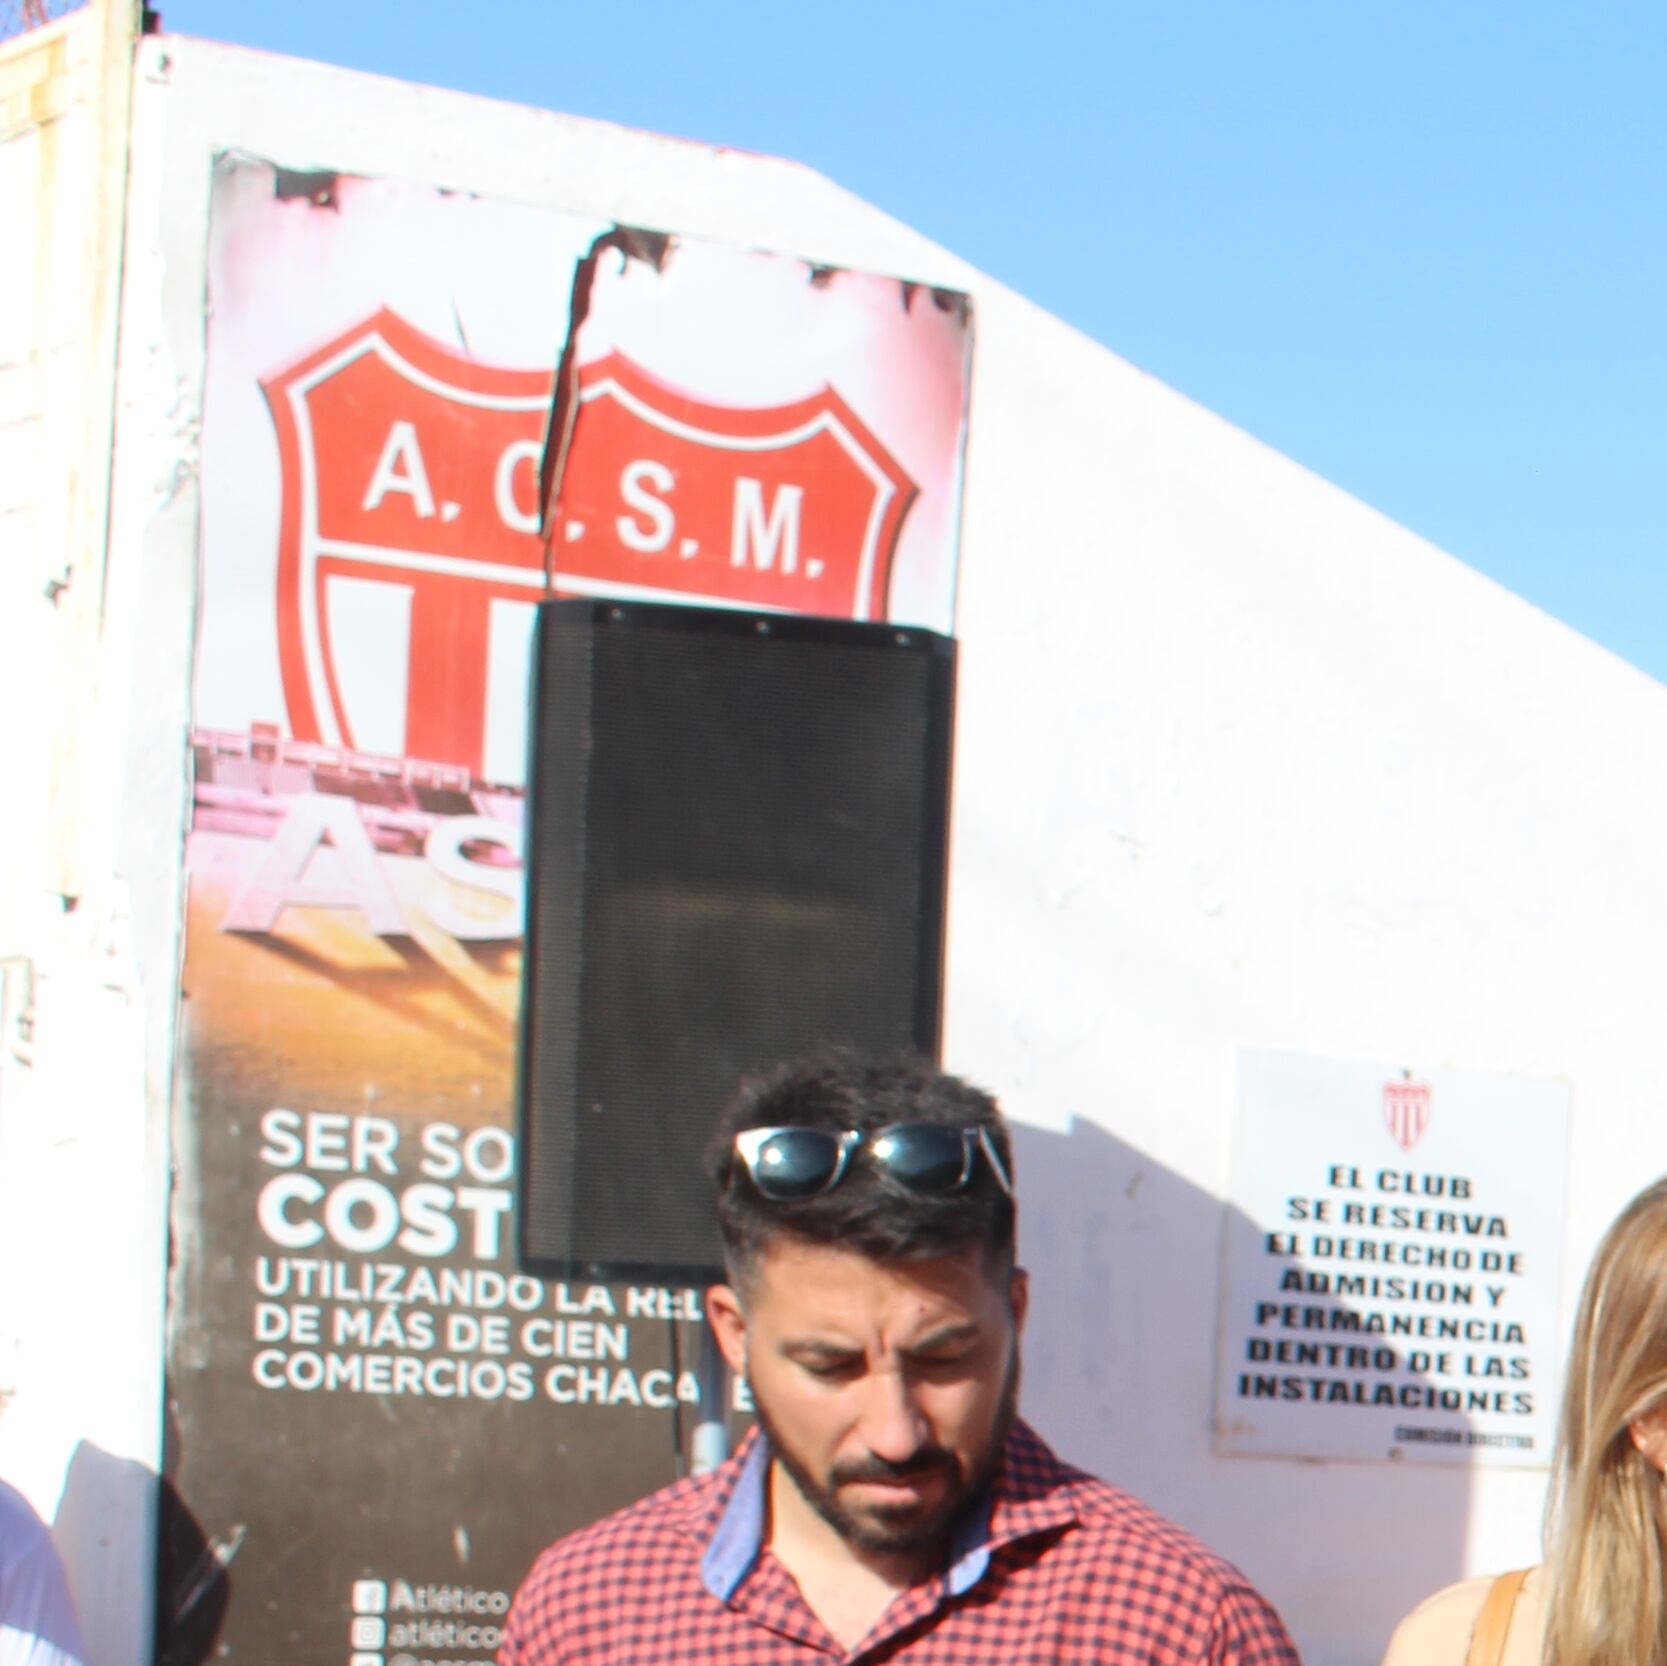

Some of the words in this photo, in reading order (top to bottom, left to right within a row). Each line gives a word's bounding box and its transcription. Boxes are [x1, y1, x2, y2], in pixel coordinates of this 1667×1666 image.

[260, 1109, 399, 1175] SER
[1329, 1165, 1363, 1190] EL
[1377, 1169, 1474, 1200] CLUB
[257, 1172, 513, 1260] COST
[1288, 1197, 1331, 1223] SE
[1343, 1203, 1509, 1239] RESERVA
[1266, 1232, 1303, 1257] EL
[1313, 1233, 1472, 1272] DERECHO
[1481, 1249, 1525, 1275] DE
[255, 1256, 544, 1311] UTILIZANDO
[556, 1283, 615, 1317] LA
[1280, 1267, 1473, 1306] ADMISION
[1488, 1286, 1505, 1307] Y
[254, 1302, 321, 1344] DE
[333, 1299, 434, 1352] MÁS
[446, 1314, 511, 1355] DE
[521, 1320, 629, 1361] CIEN
[1256, 1303, 1526, 1344] PERMANENCIA
[252, 1350, 535, 1400] COMERCIOS
[1248, 1338, 1397, 1371] DENTRO
[1409, 1350, 1455, 1374] DE
[1466, 1355, 1530, 1379] LAS
[1238, 1375, 1534, 1415] INSTALACIONES
